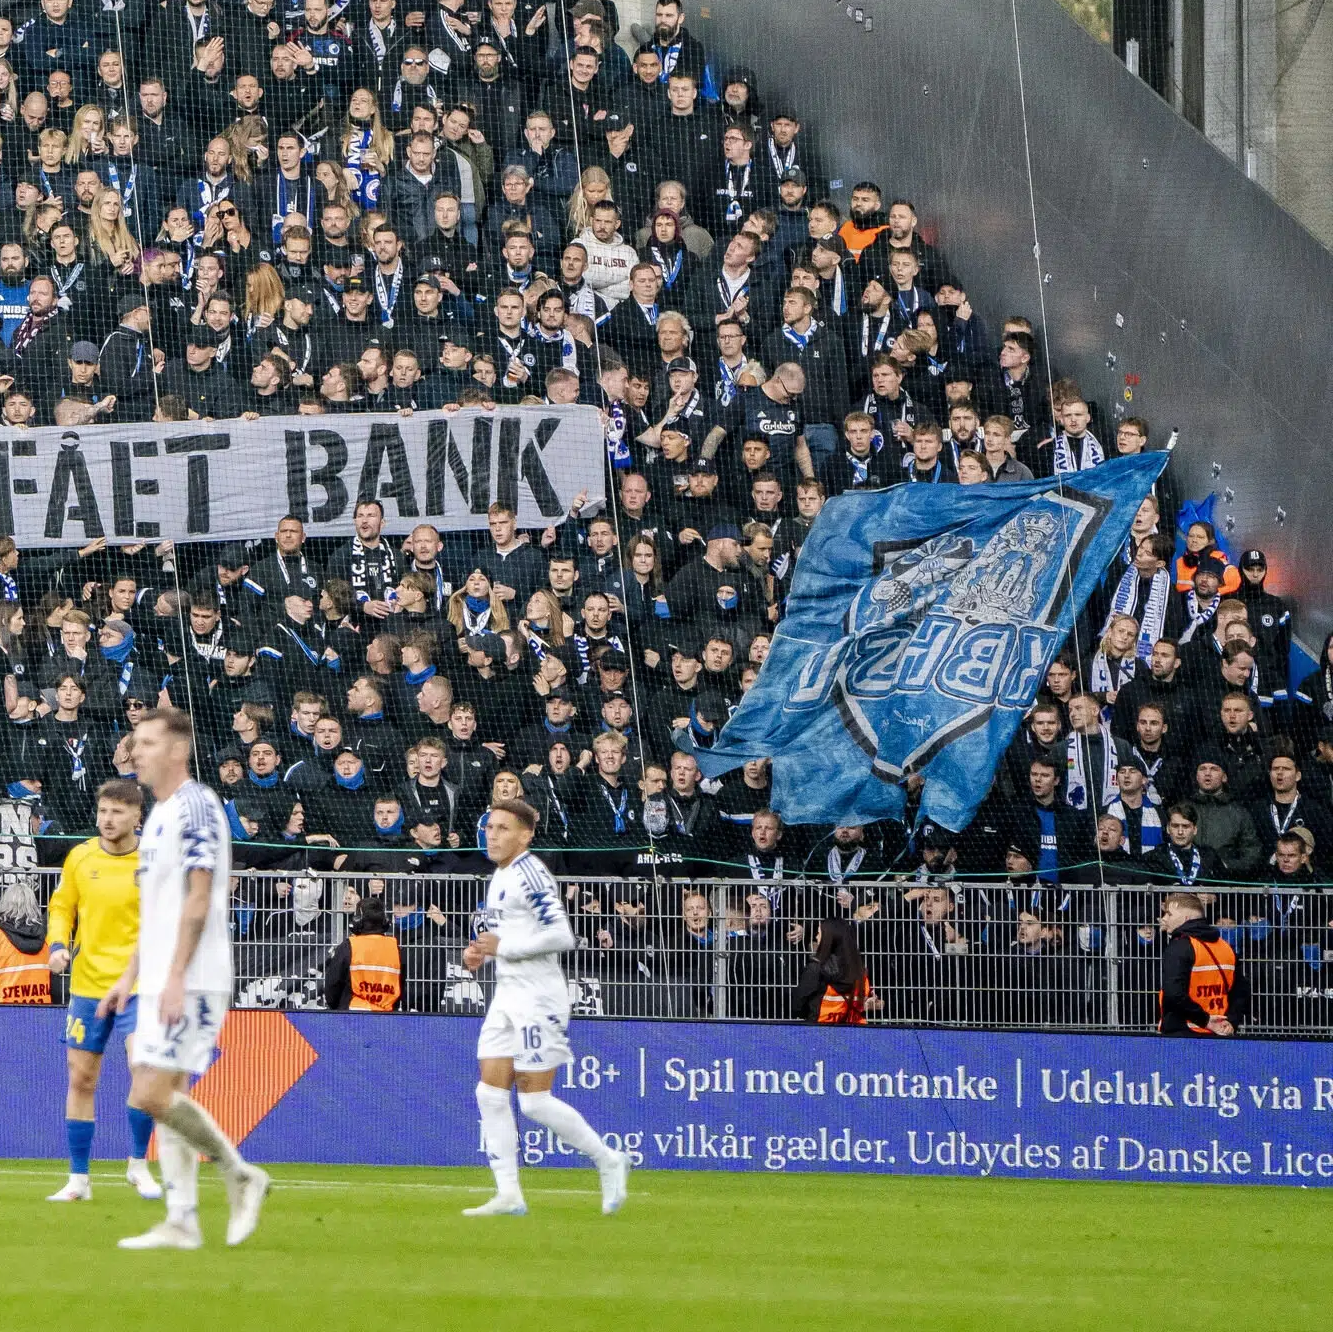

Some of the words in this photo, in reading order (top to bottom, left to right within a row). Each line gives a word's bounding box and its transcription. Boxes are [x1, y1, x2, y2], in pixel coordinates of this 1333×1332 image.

[759, 419, 796, 435] Carlsberg
[283, 416, 564, 526] BANK
[521, 1026, 542, 1050] 16
[562, 1055, 621, 1090] 18+
[664, 1057, 735, 1102] Spil
[744, 1060, 826, 1095] med
[835, 1065, 999, 1102] omtanke
[1041, 1068, 1174, 1107] Udeluk
[1182, 1073, 1240, 1118] dig
[1248, 1077, 1303, 1111] via
[652, 1124, 757, 1160] vilkår
[764, 1127, 896, 1170] gælder.
[907, 1130, 1061, 1177] Udbydes
[1071, 1135, 1109, 1170] af
[1117, 1137, 1252, 1175] Danske
